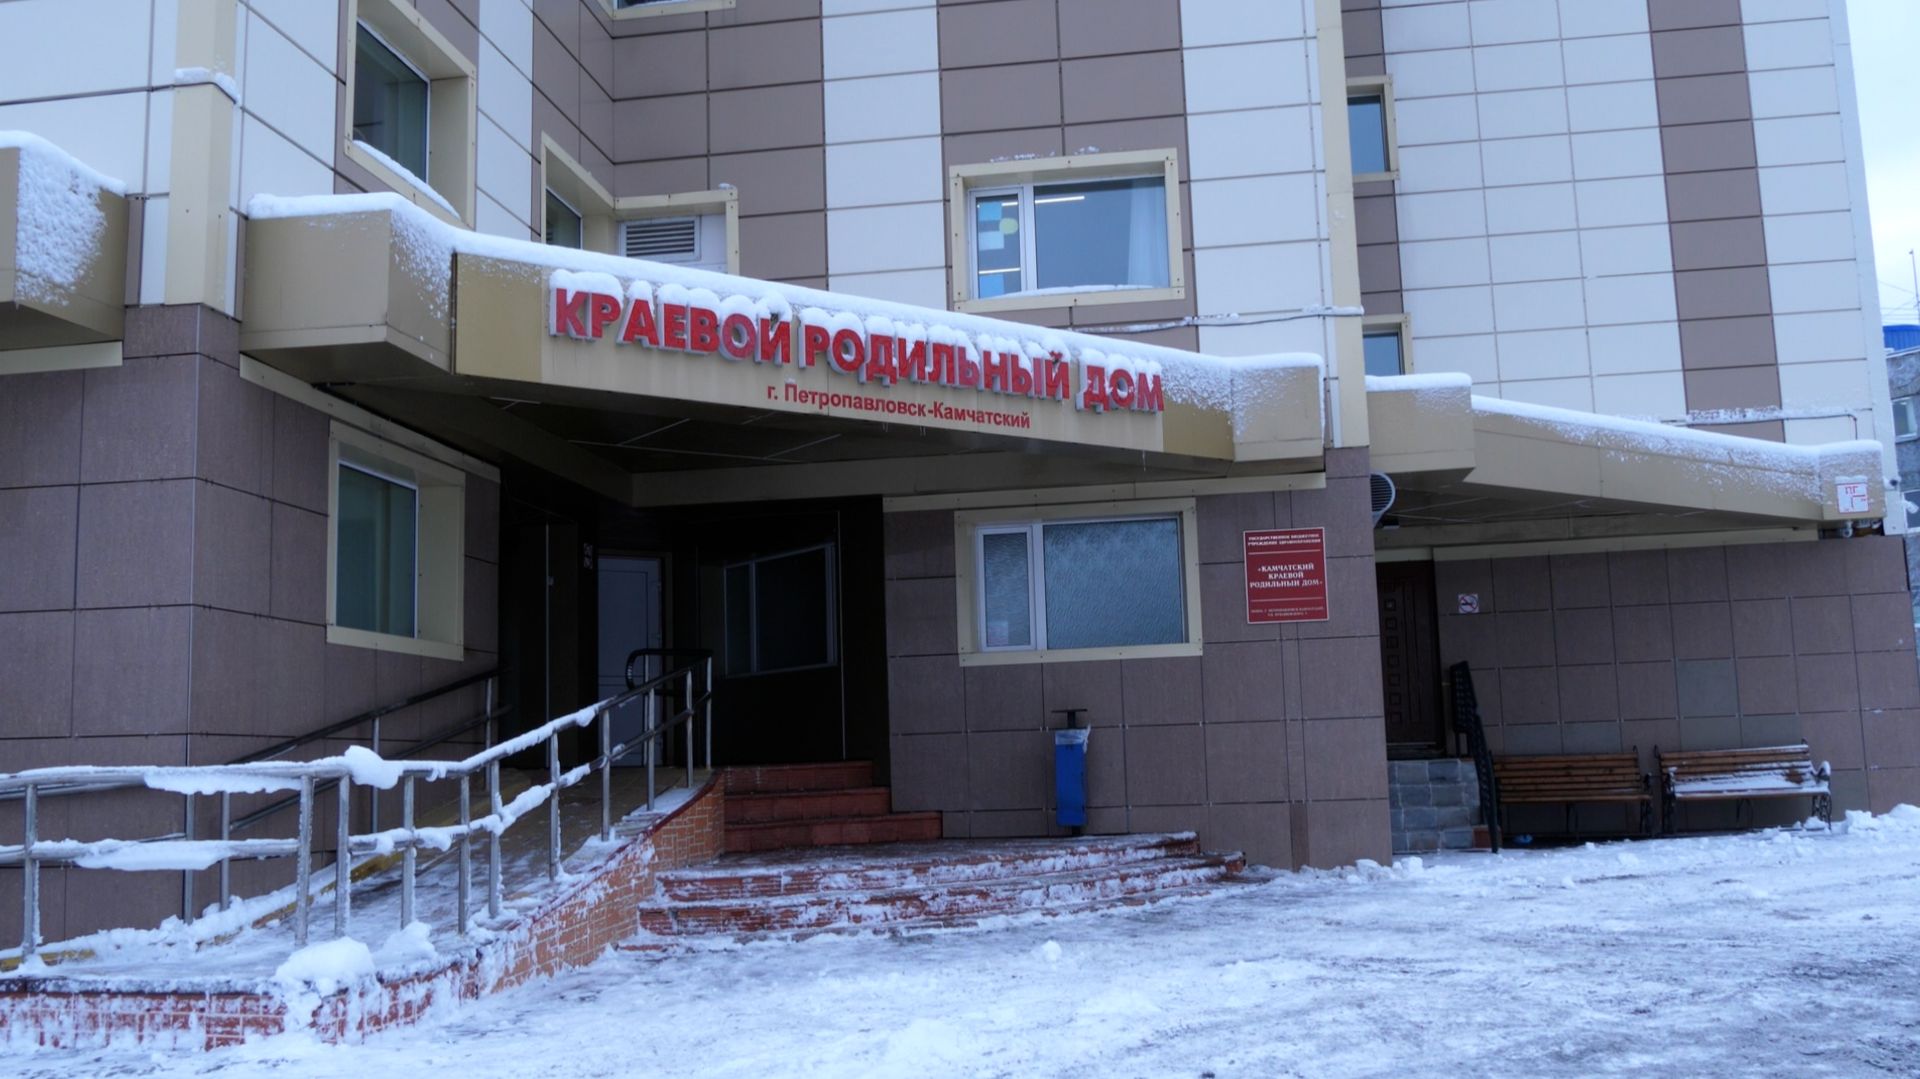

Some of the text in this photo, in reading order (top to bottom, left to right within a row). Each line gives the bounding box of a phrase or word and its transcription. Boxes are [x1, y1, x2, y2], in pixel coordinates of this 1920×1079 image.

[799, 324, 1070, 401] РОДИЛЬНЫЙ
[1076, 364, 1165, 414] ДОМ
[767, 383, 1030, 429] г. Петропавловск-Камчатский
